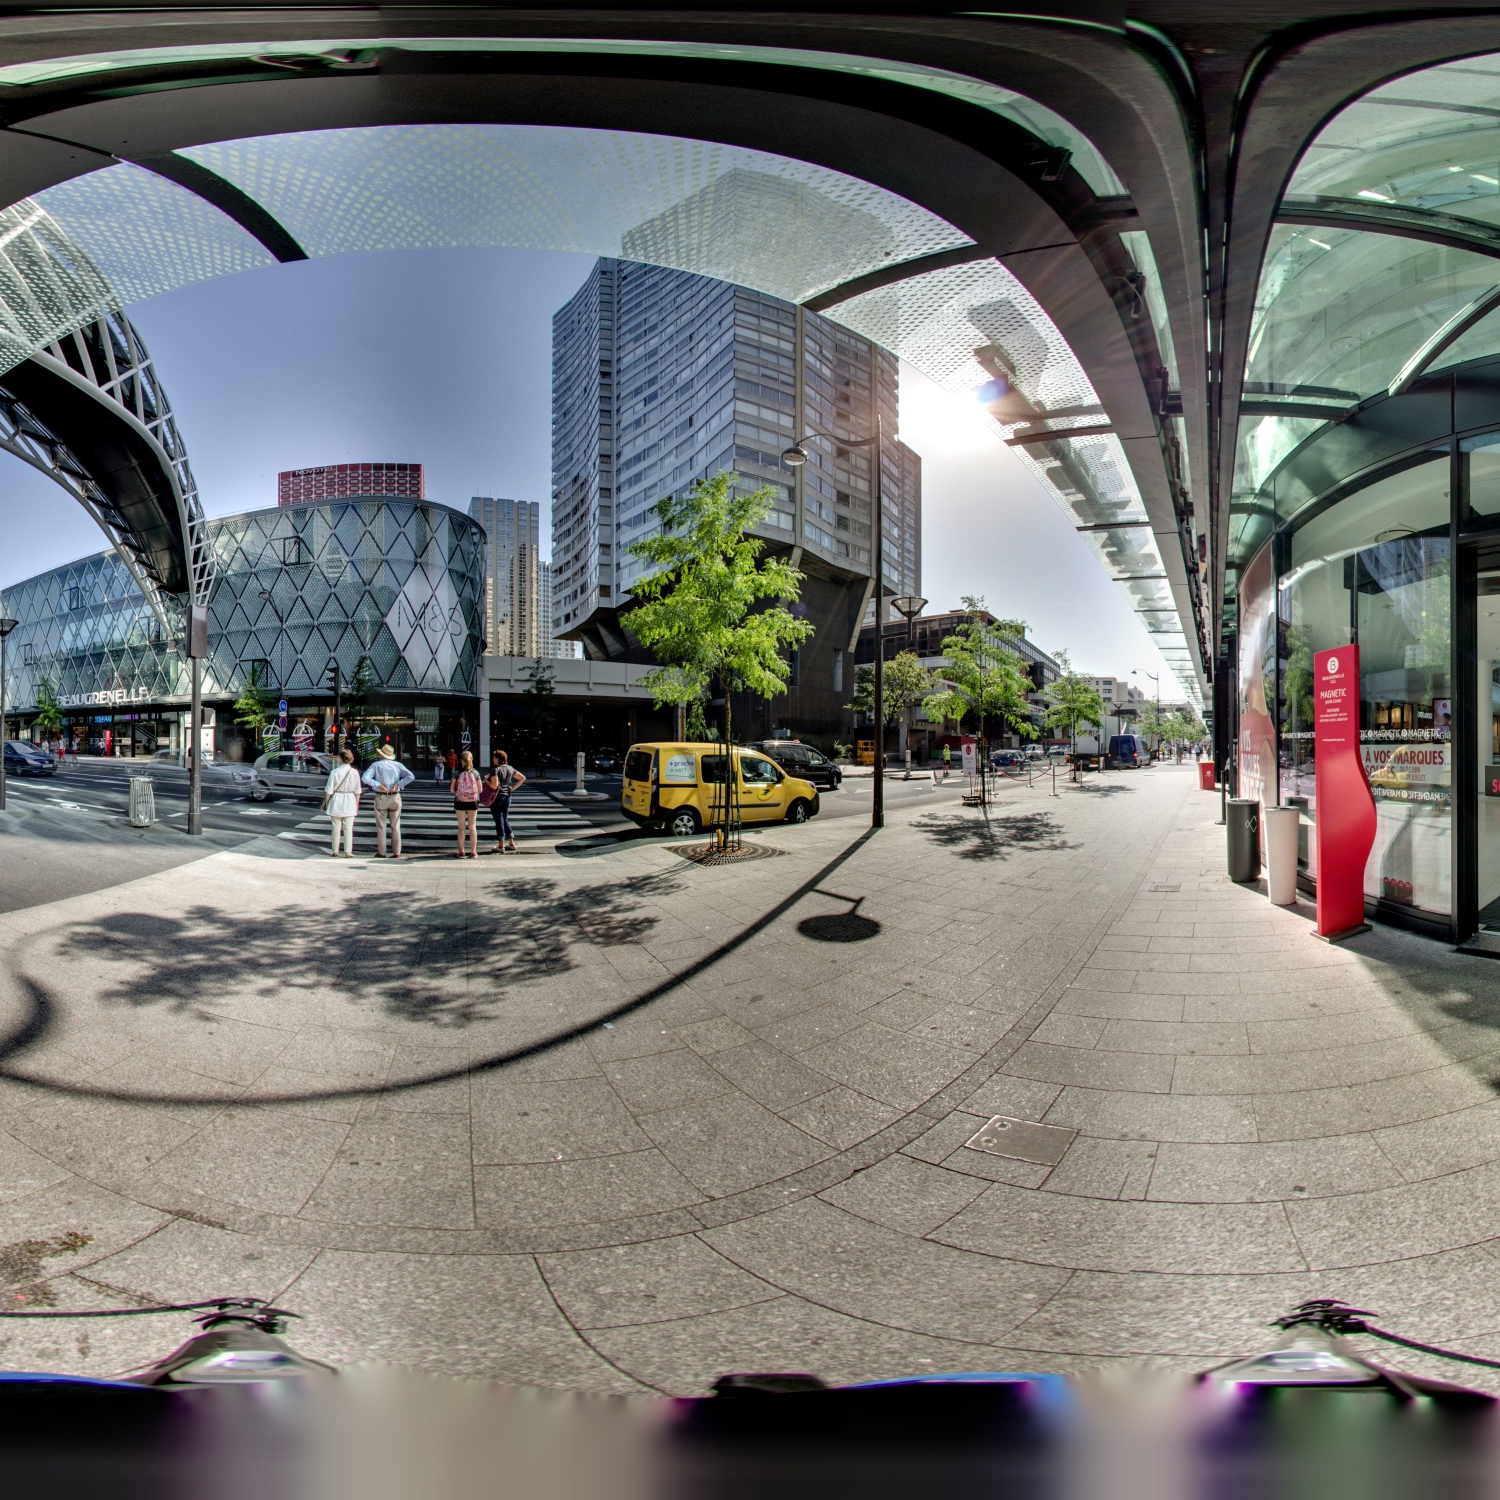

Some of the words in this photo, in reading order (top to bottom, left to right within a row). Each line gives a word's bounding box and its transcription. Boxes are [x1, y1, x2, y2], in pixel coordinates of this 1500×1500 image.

[295, 466, 336, 476] NOVOTEL
[397, 599, 463, 637] M&S
[57, 686, 150, 707] BEAUGRENELLE
[1320, 687, 1347, 699] MAGNETIC
[1365, 747, 1371, 761] À
[1373, 750, 1391, 764] VOS
